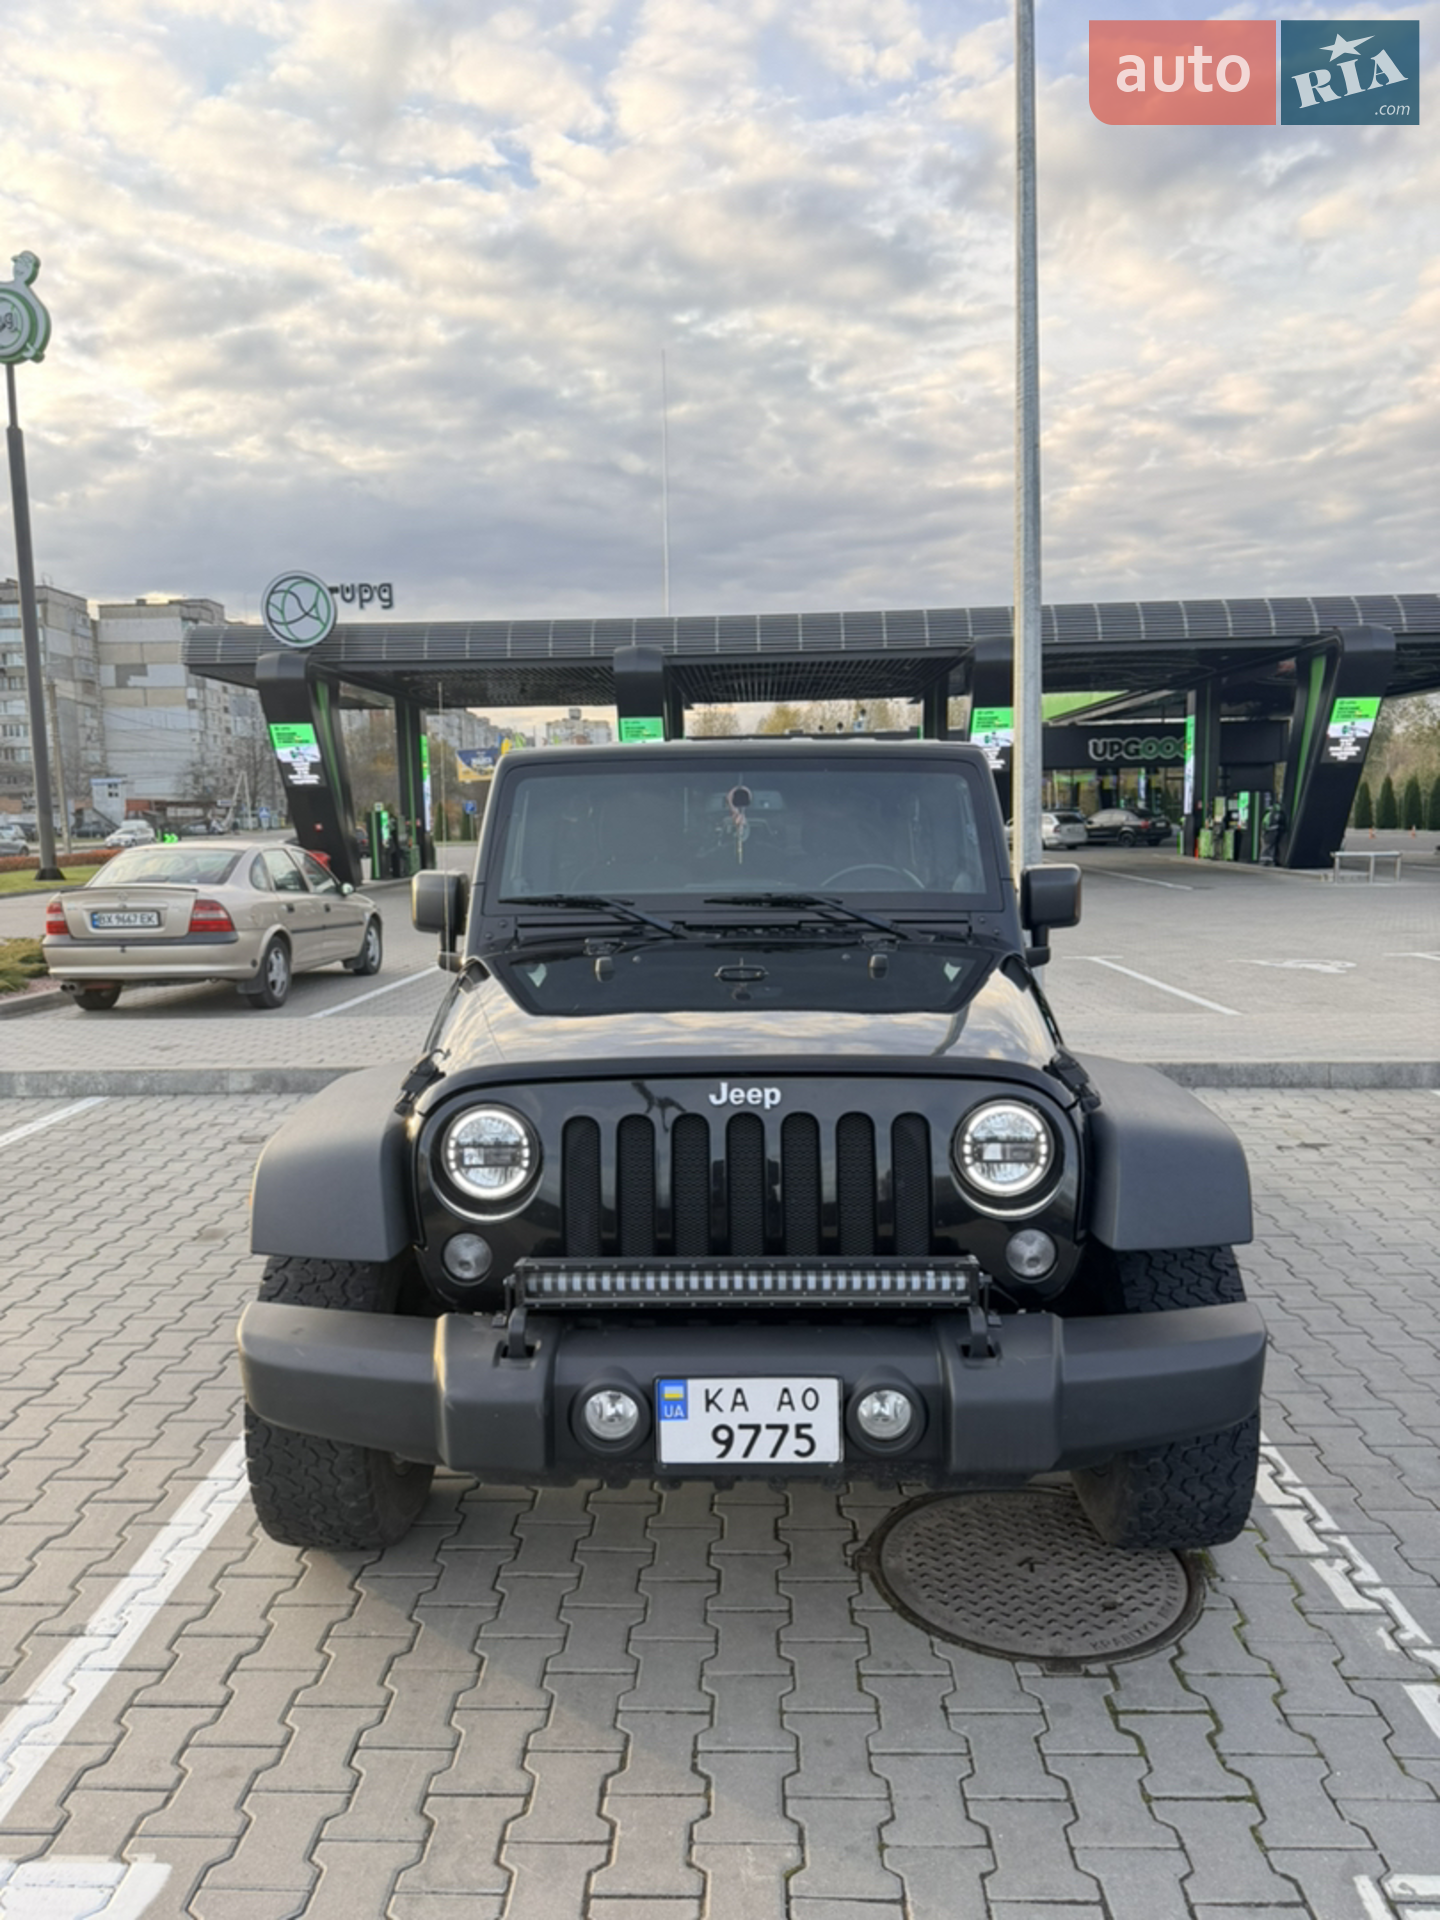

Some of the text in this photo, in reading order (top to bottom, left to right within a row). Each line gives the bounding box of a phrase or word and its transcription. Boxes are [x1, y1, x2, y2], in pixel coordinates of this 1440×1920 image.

[340, 582, 394, 610] upg
[708, 1082, 782, 1110] Jeep
[664, 1405, 685, 1419] UA
[705, 1387, 749, 1413] KA
[711, 1423, 817, 1459] 9775
